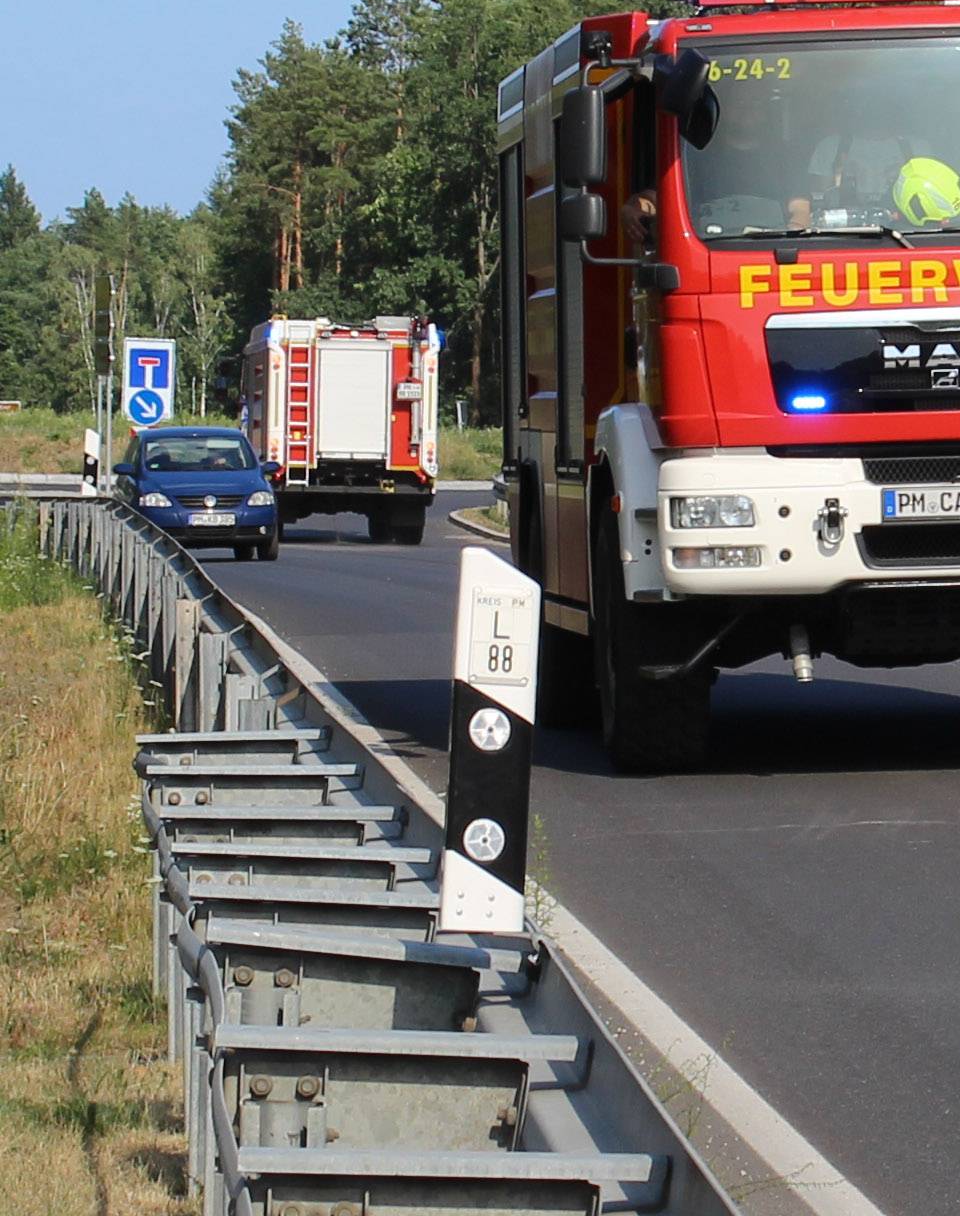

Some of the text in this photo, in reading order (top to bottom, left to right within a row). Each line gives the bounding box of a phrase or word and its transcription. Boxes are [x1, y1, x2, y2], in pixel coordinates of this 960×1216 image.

[898, 493, 925, 513] PM
[477, 597, 502, 606] KREIS
[493, 610, 510, 639] L
[488, 644, 513, 673] 88
